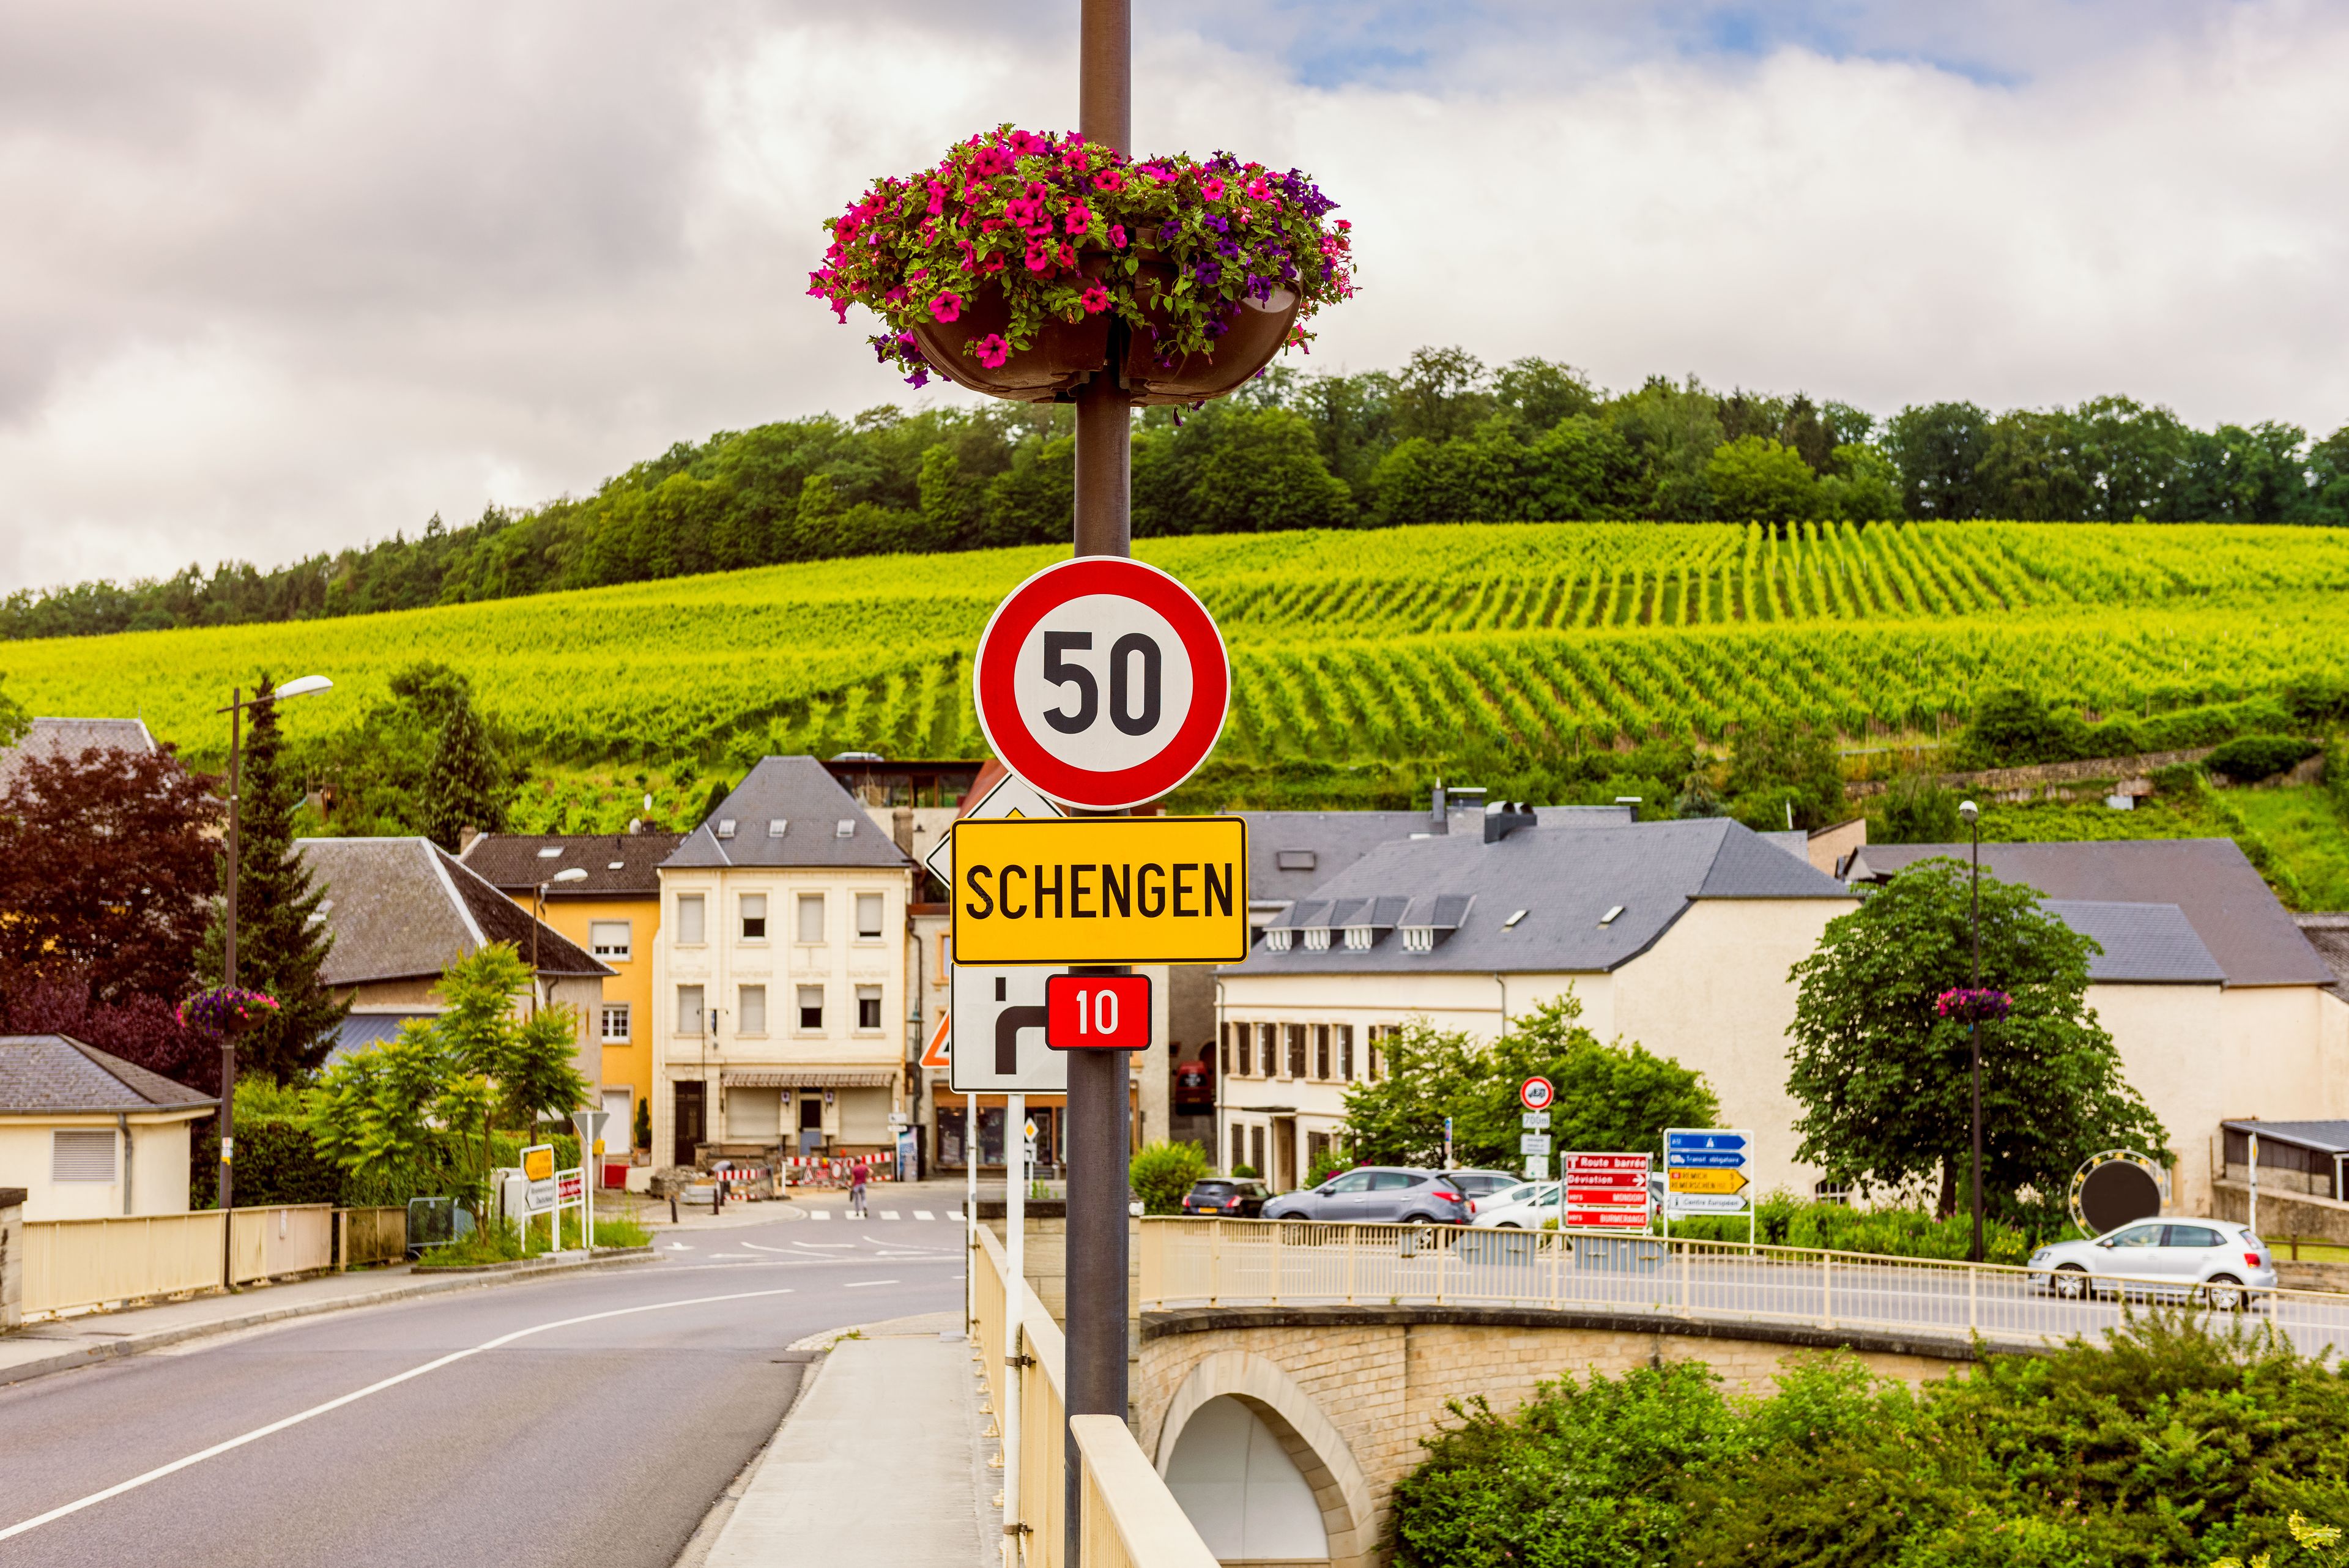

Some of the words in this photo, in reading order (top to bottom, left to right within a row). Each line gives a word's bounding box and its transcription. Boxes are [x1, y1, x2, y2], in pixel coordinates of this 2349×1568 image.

[1043, 631, 1162, 736] 50
[966, 862, 1233, 920] SCHENGEN
[1075, 989, 1119, 1036] 10
[1525, 1115, 1549, 1124] 700m
[1581, 1157, 1609, 1167] Route
[1614, 1157, 1646, 1168] barrée
[1568, 1174, 1613, 1184] Déviation
